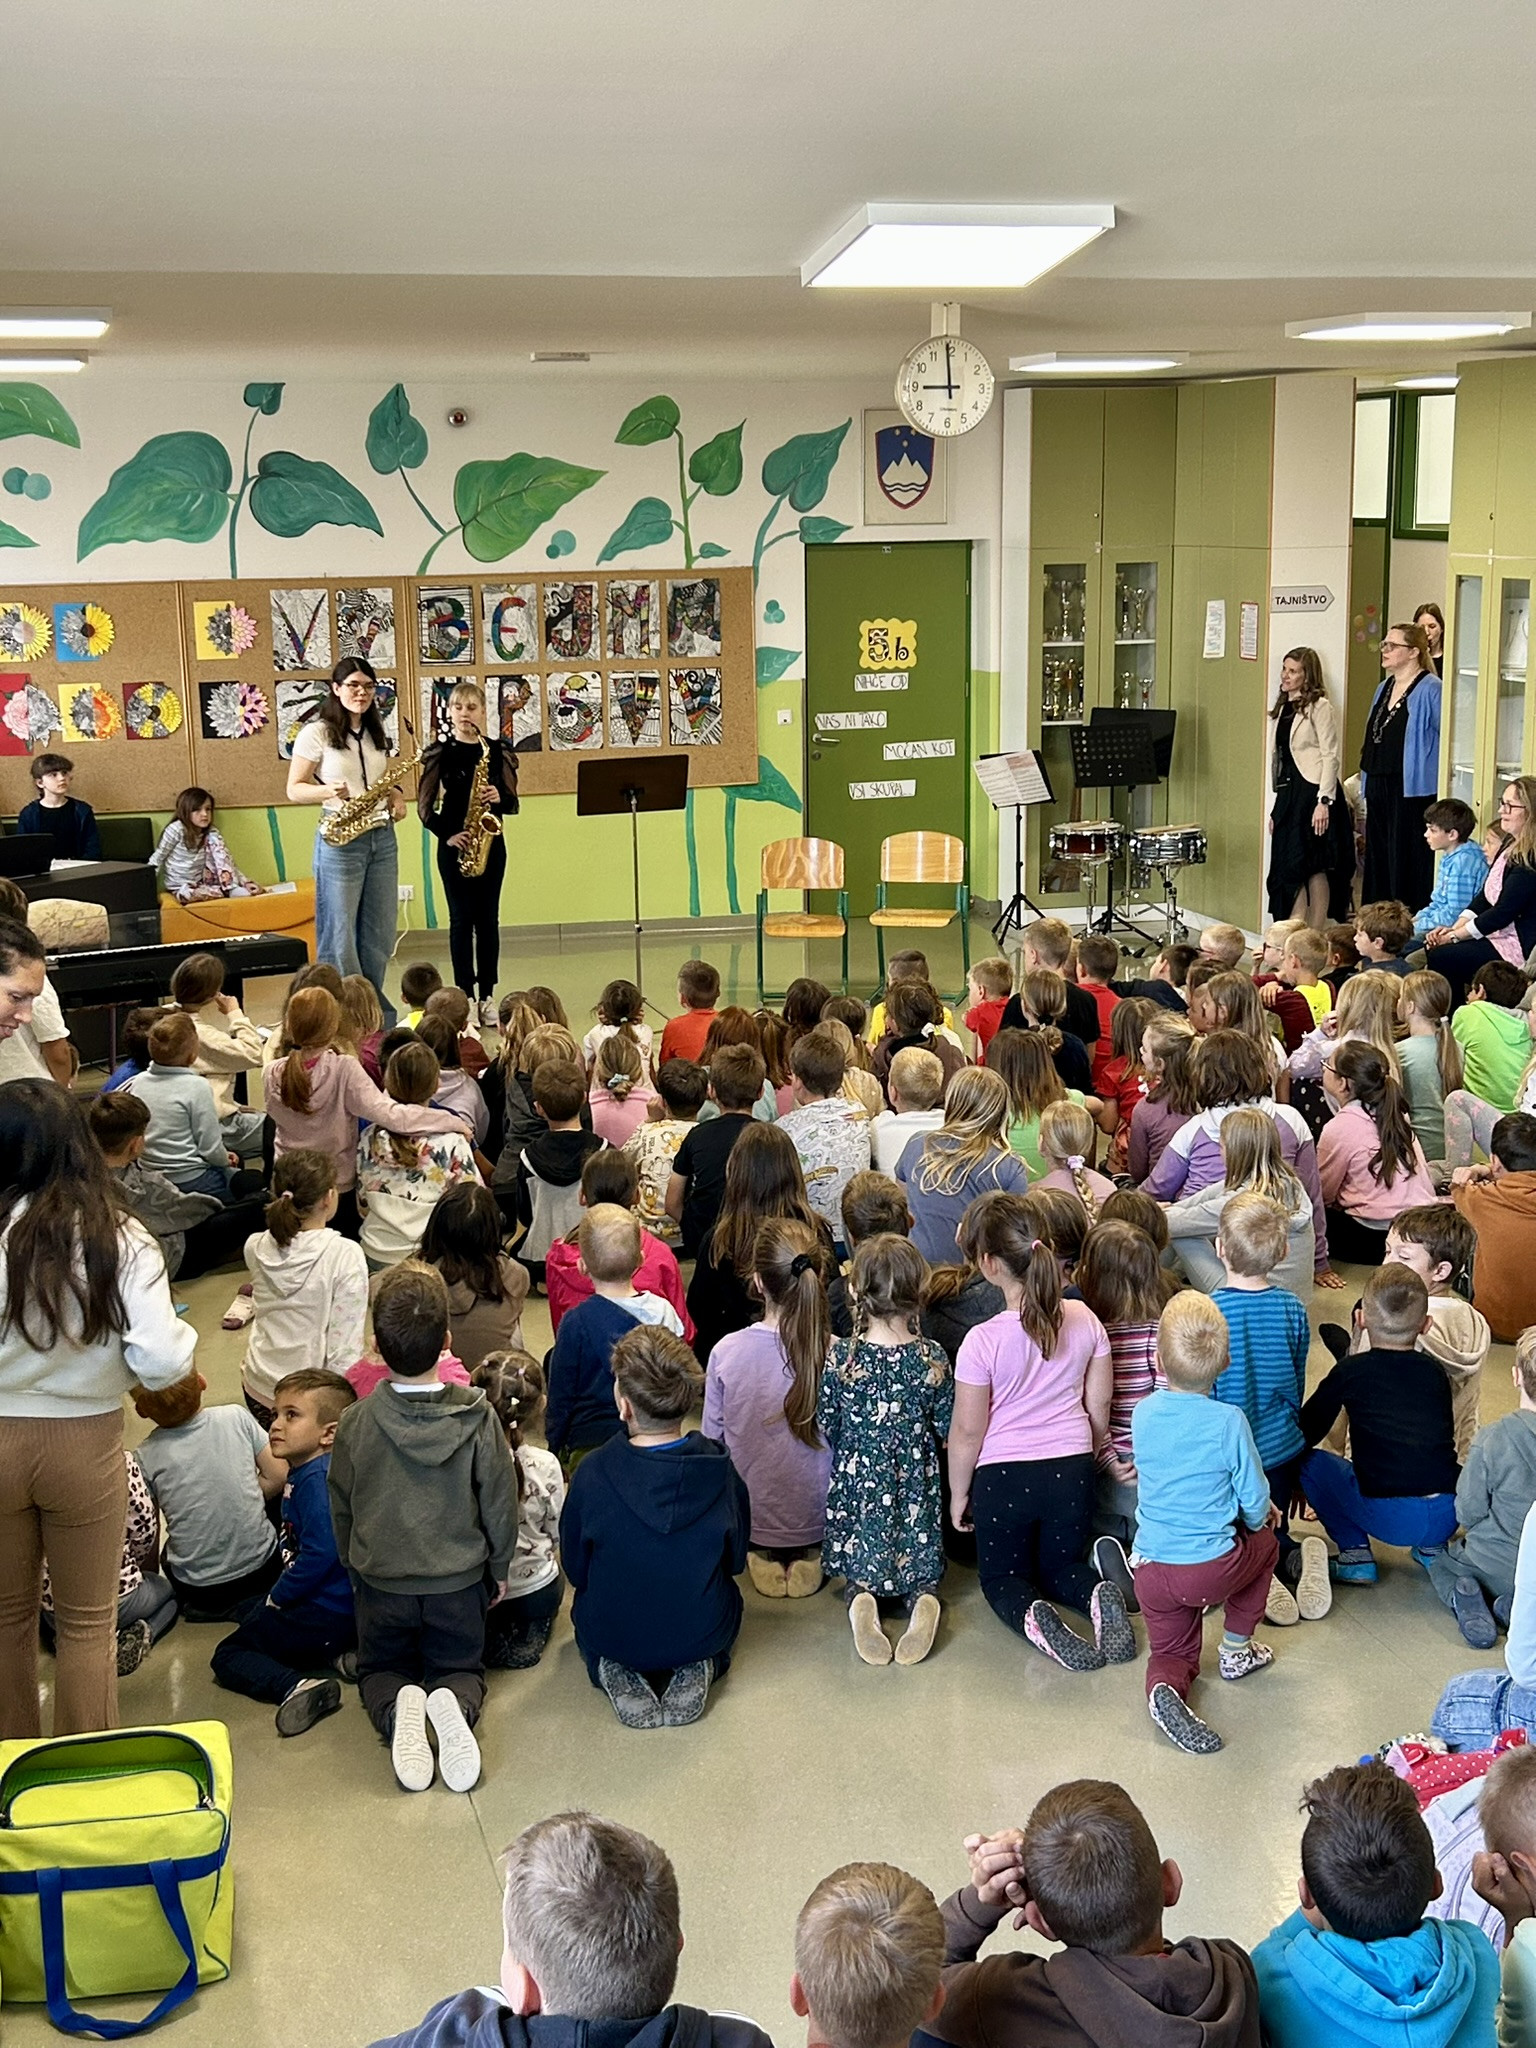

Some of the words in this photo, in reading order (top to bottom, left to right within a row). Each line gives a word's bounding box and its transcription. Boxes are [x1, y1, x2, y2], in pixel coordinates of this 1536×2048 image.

[929, 351, 938, 362] 11
[963, 352, 968, 362] 1
[917, 362, 927, 373] 10
[973, 364, 981, 375] 2
[911, 381, 919, 392] 9
[978, 383, 985, 394] 3
[916, 400, 923, 411] 8
[971, 401, 979, 411] 4
[928, 412, 935, 423] 7
[944, 417, 951, 428] 6
[960, 413, 967, 424] 5
[1275, 594, 1327, 605] TAJNIŠTVO
[890, 674, 908, 690] OD
[845, 714, 856, 728] NI
[859, 711, 886, 727] TAKO
[931, 740, 954, 756] KOT
